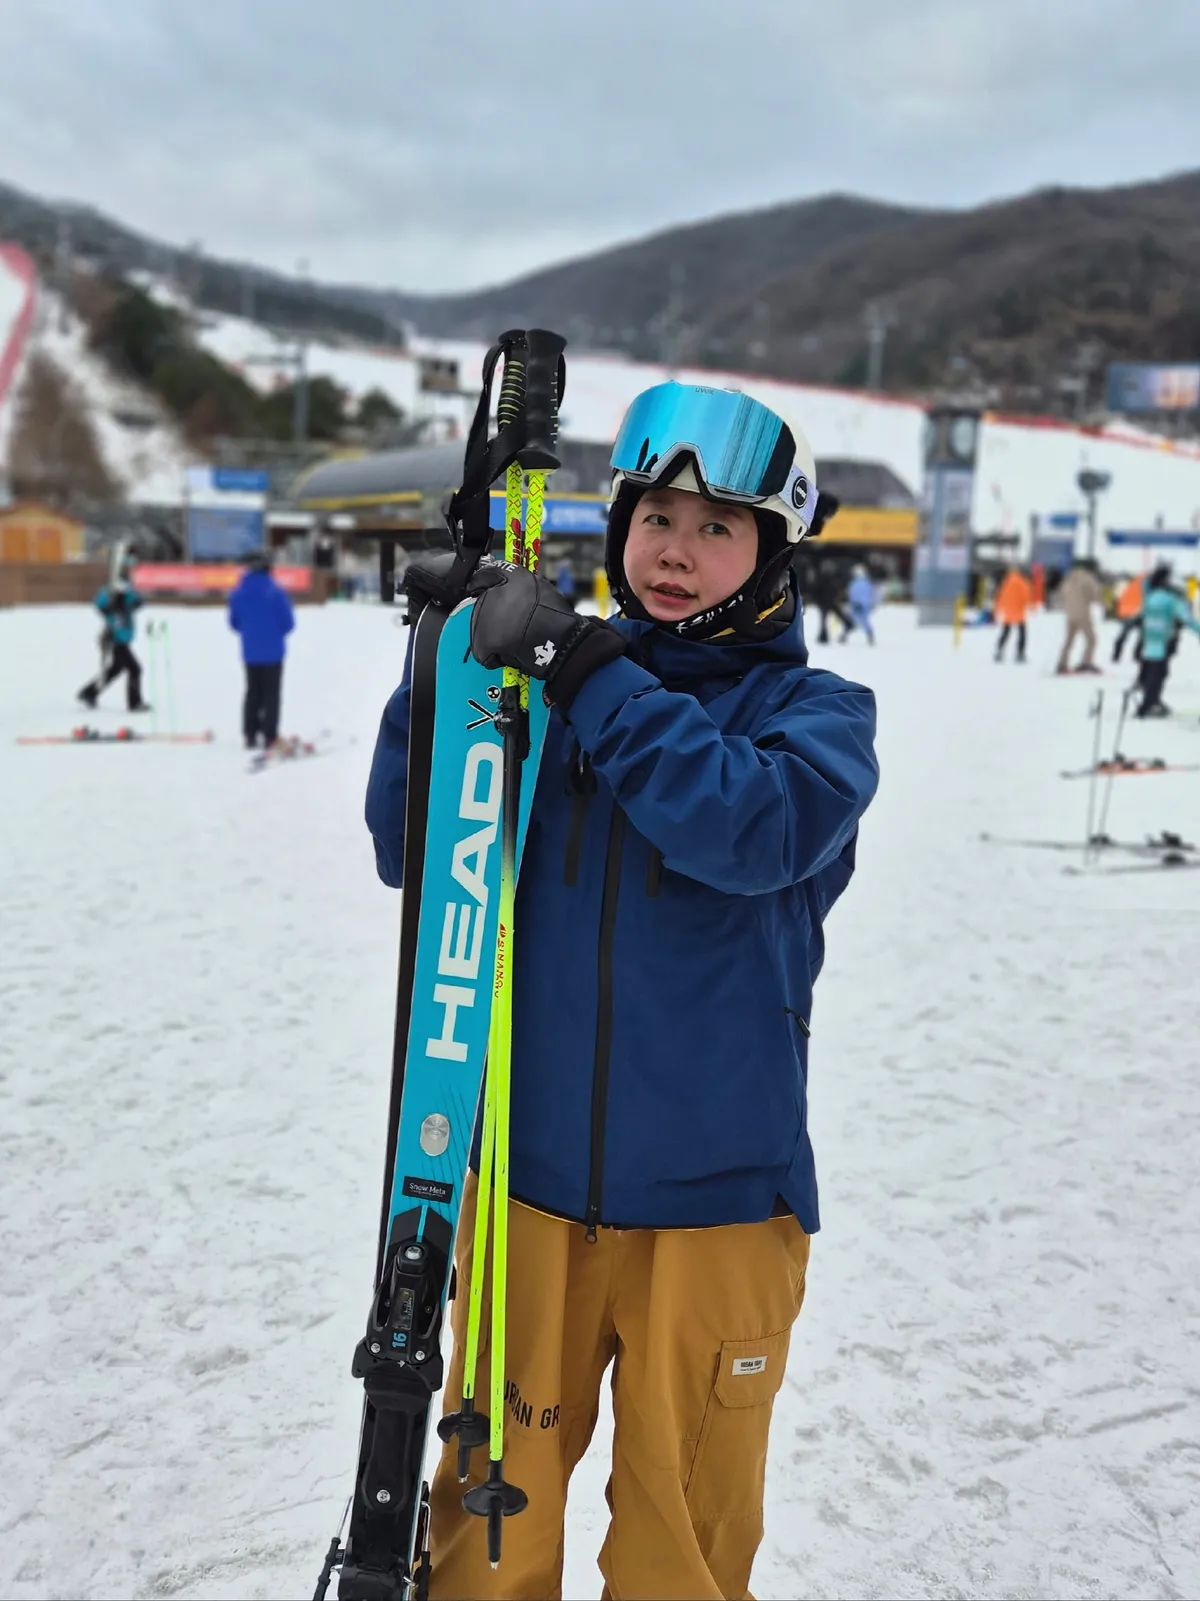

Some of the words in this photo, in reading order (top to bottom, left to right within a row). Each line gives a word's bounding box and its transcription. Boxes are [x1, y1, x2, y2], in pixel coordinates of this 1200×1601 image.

[425, 741, 504, 1062] HEAD
[409, 1182, 428, 1192] Snow
[429, 1186, 446, 1195] Meta
[391, 1332, 408, 1349] 16
[540, 1404, 560, 1430] GR
